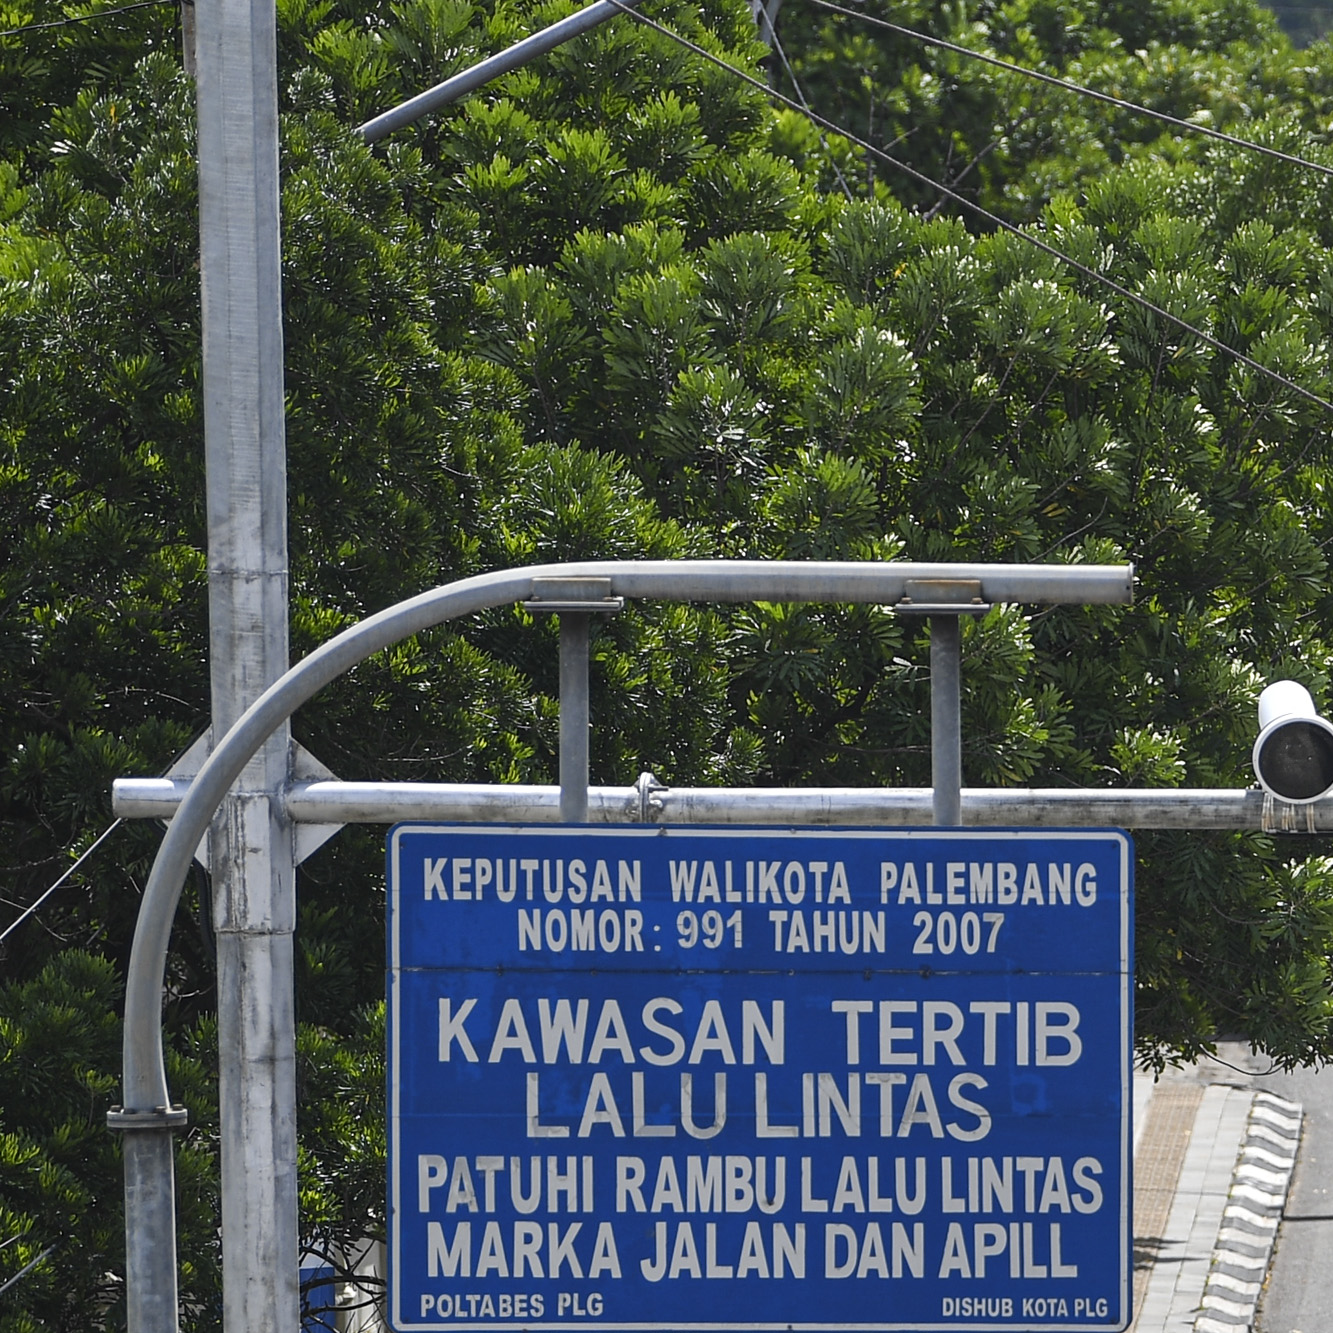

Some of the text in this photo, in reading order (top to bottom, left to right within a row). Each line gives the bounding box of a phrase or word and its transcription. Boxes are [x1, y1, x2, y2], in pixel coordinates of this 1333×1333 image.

[425, 858, 1096, 906] KEPUTUSAN WALIKOTA PALEMBANG
[677, 911, 742, 948] 991
[770, 911, 885, 954] TAHUN
[913, 911, 1004, 954] 2007
[439, 998, 1082, 1066] KAWASAN TERTIB
[527, 1072, 992, 1142] LALU LINTAS
[419, 1155, 1102, 1214] PATUHI RAMBU LALU LINTAS
[428, 1222, 1077, 1281] MARKA JALAN DAN APILL
[422, 1293, 602, 1317] POLTABES PLG
[943, 1298, 1107, 1316] DISHUB KOTA PLG
